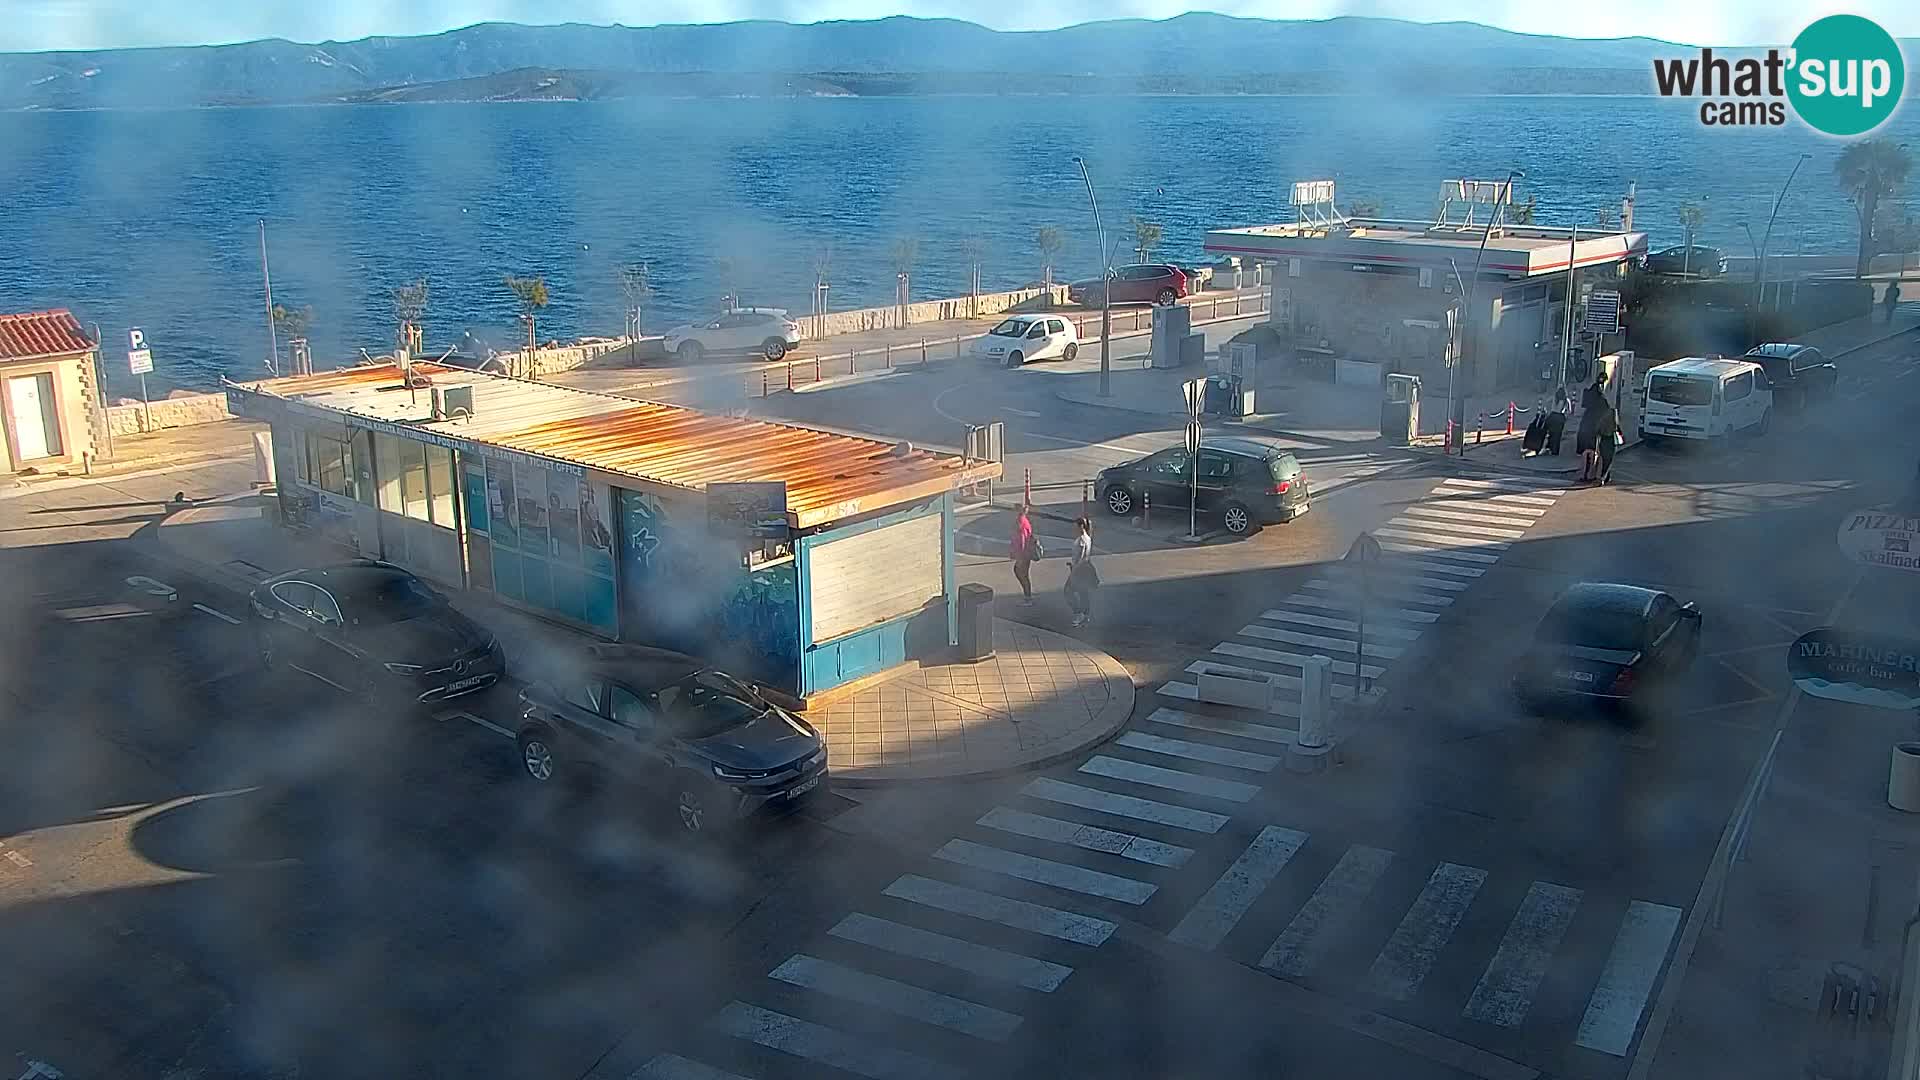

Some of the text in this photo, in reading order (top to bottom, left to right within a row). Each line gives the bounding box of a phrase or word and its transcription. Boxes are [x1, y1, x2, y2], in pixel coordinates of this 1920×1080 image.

[130, 330, 144, 350] P
[528, 456, 556, 471] TICKET
[556, 463, 583, 477] OFFICE
[1869, 664, 1896, 680] bar
